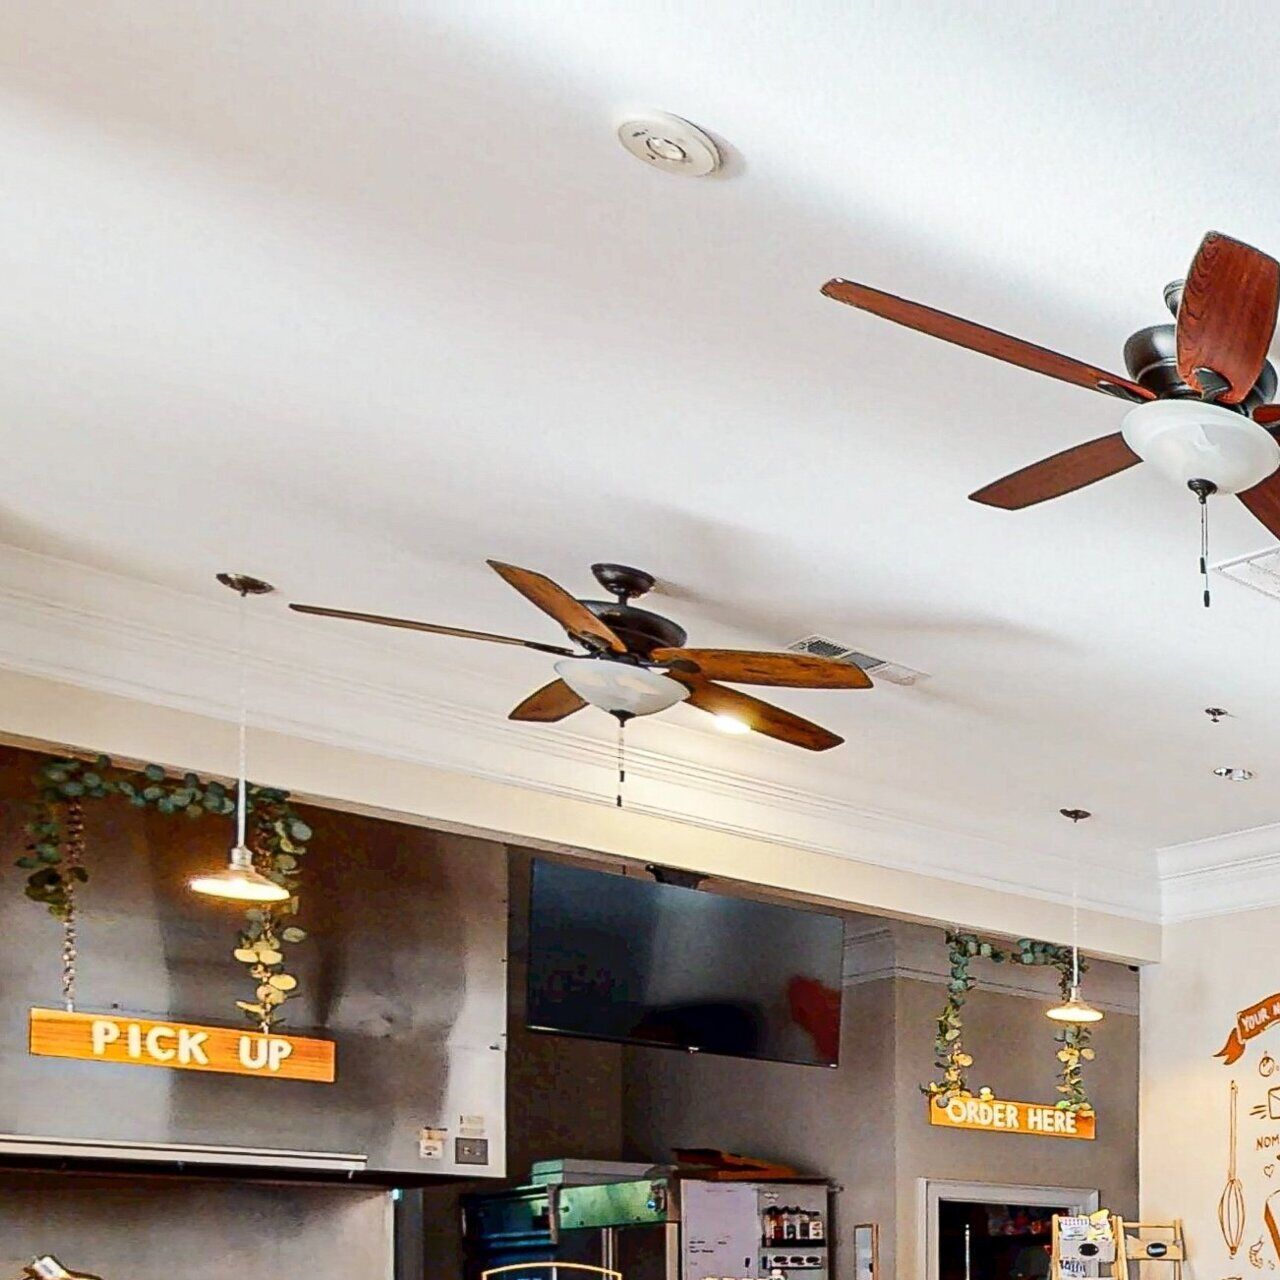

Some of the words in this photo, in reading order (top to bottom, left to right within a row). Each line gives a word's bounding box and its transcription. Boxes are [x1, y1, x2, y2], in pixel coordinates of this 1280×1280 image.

[1241, 1008, 1269, 1031] YOUR
[91, 1019, 209, 1065] PICK
[239, 1035, 292, 1072] UP
[947, 1100, 1019, 1129] ORDER
[1027, 1108, 1077, 1134] HERE
[1256, 1135, 1280, 1150] NOM
